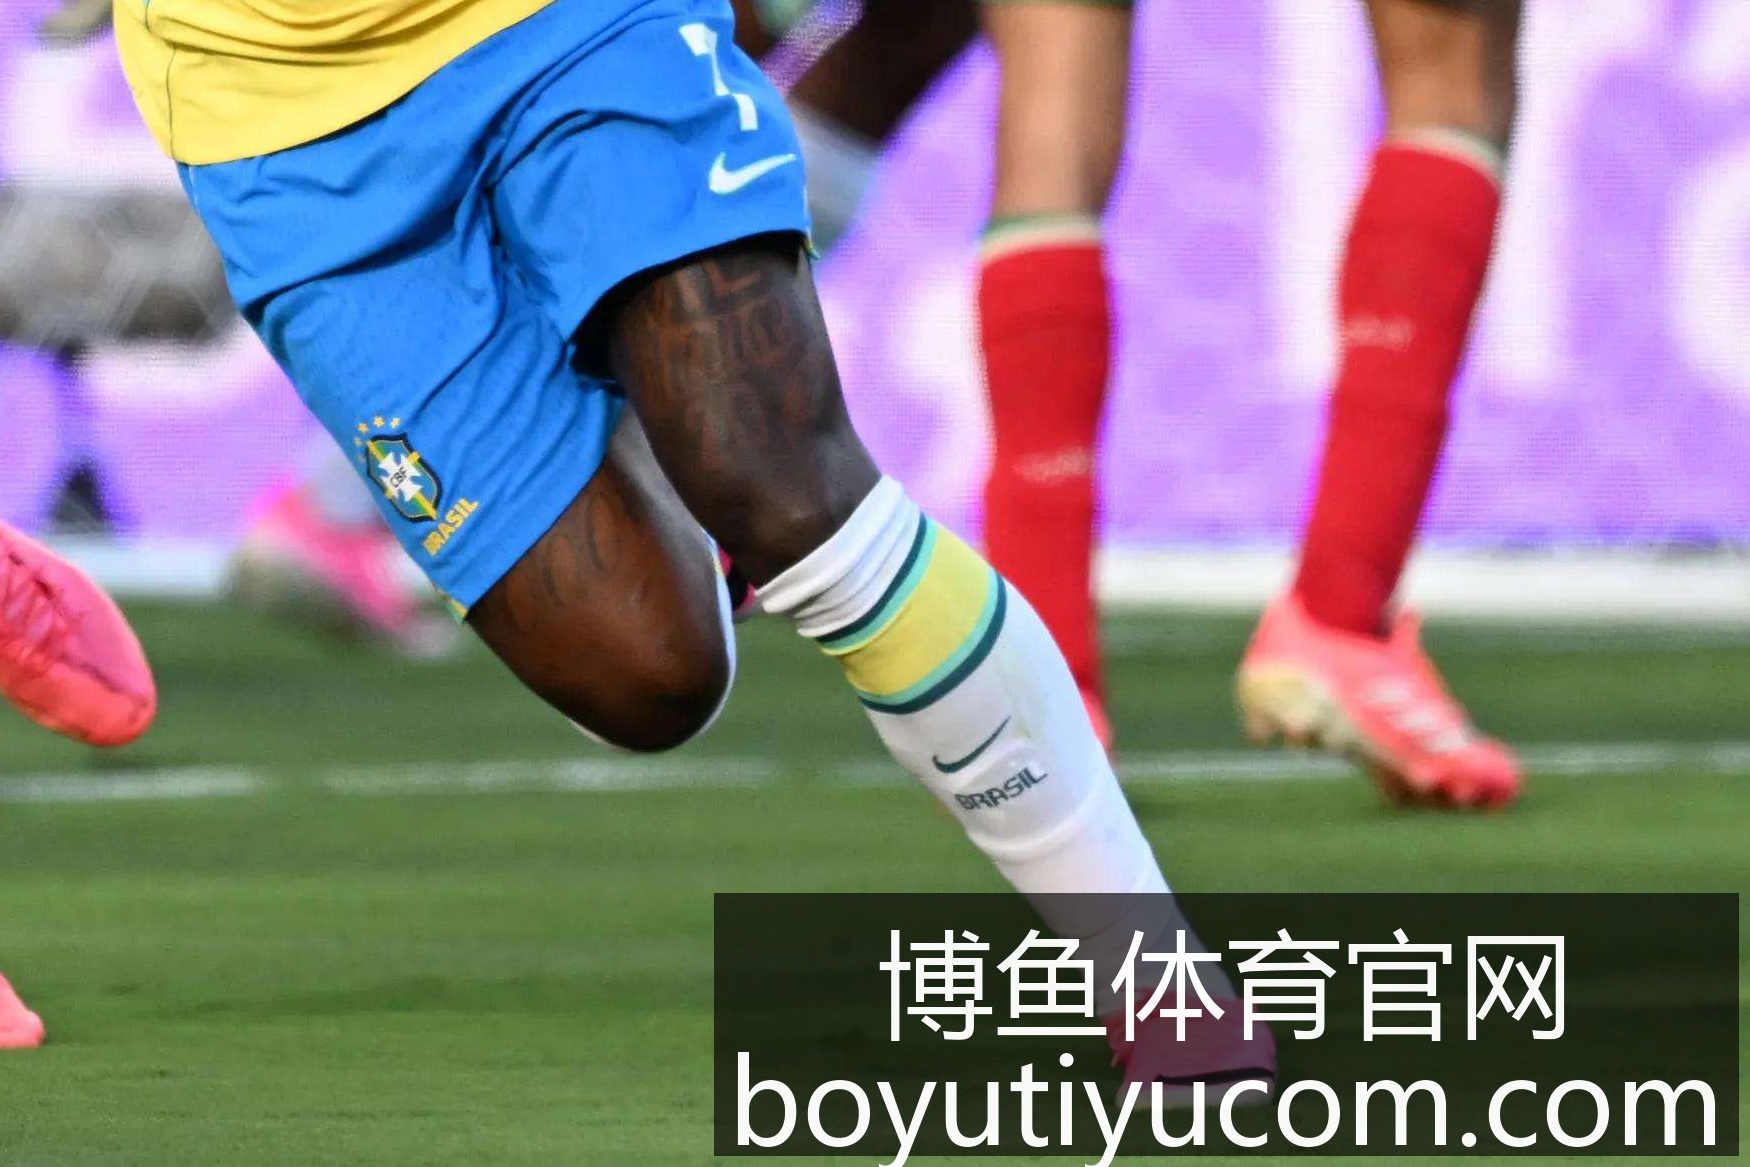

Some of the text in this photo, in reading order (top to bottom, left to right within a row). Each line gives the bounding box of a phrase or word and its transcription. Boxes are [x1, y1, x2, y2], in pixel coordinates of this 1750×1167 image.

[389, 466, 407, 489] CBF
[422, 497, 479, 556] BRASIL
[954, 766, 1049, 811] BRASIL
